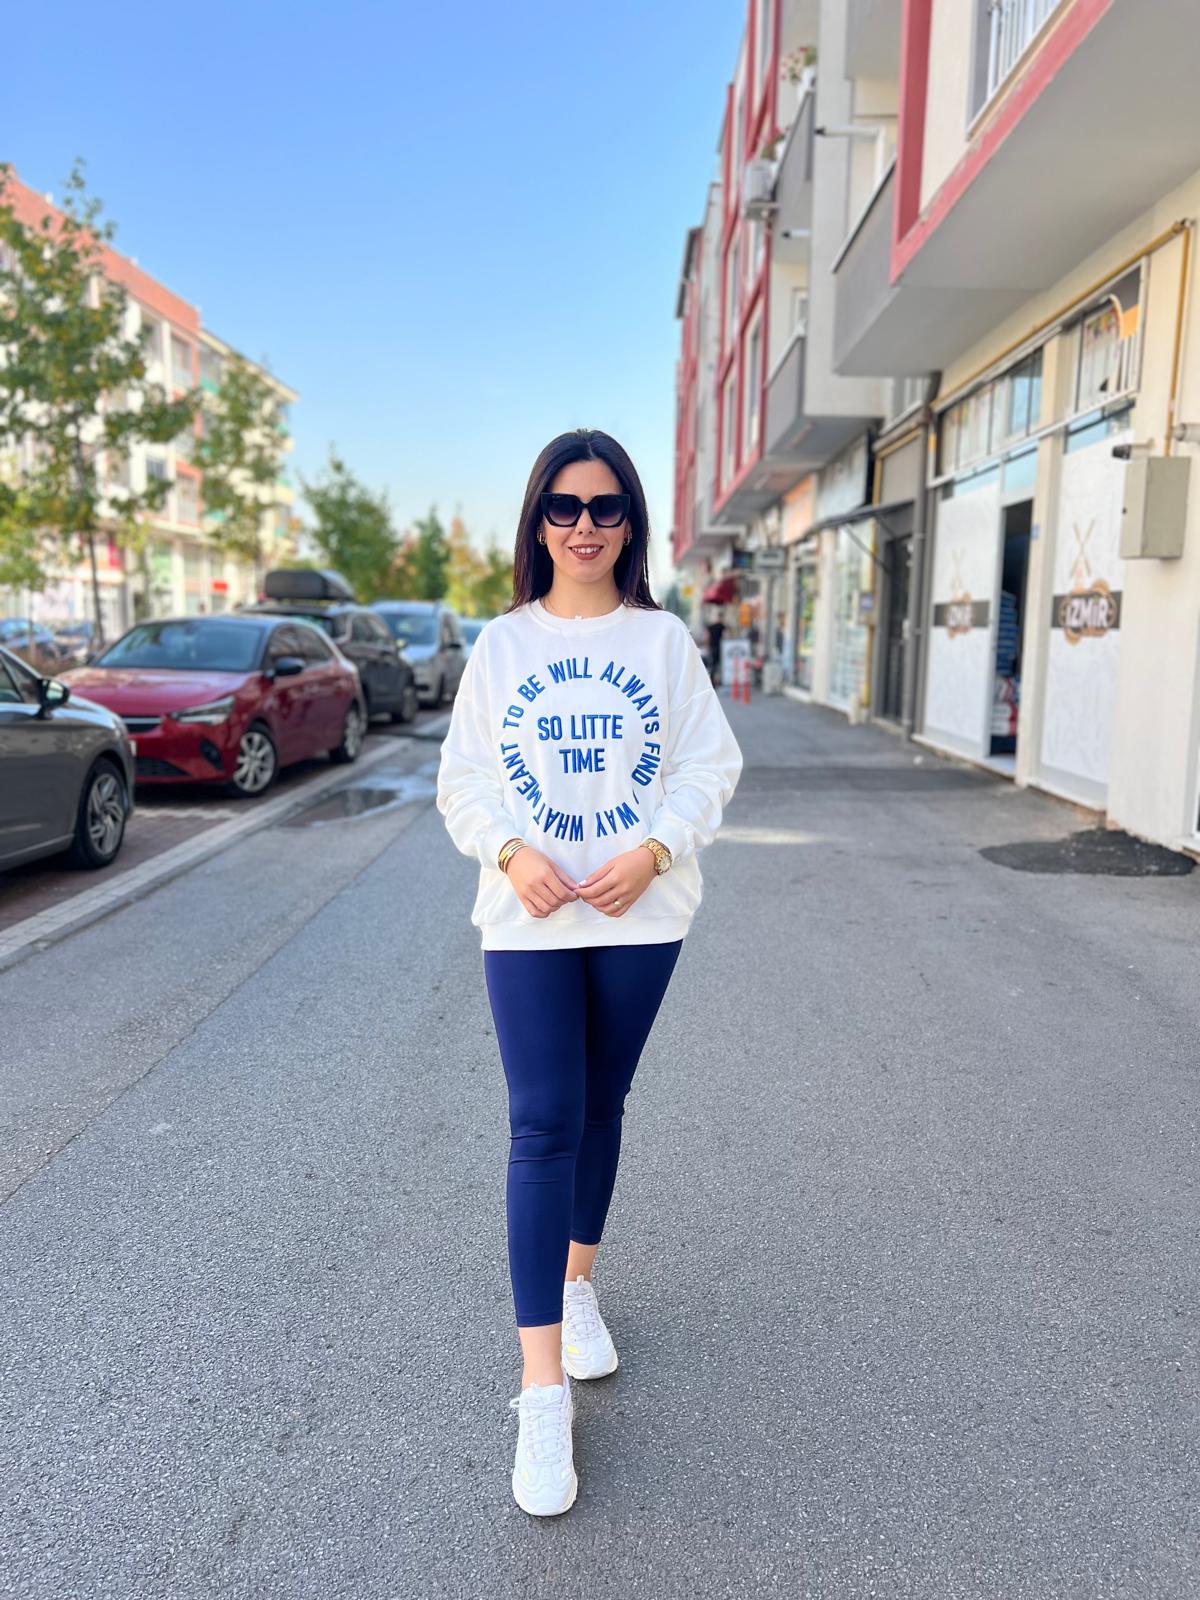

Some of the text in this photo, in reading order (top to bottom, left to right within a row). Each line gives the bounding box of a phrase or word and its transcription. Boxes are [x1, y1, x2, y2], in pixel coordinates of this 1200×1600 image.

[537, 714, 624, 741] SO LITTE
[500, 656, 662, 842] WHAT MEANT TO BE WILL ALWAYS FIND WAY
[559, 747, 606, 774] TIME
